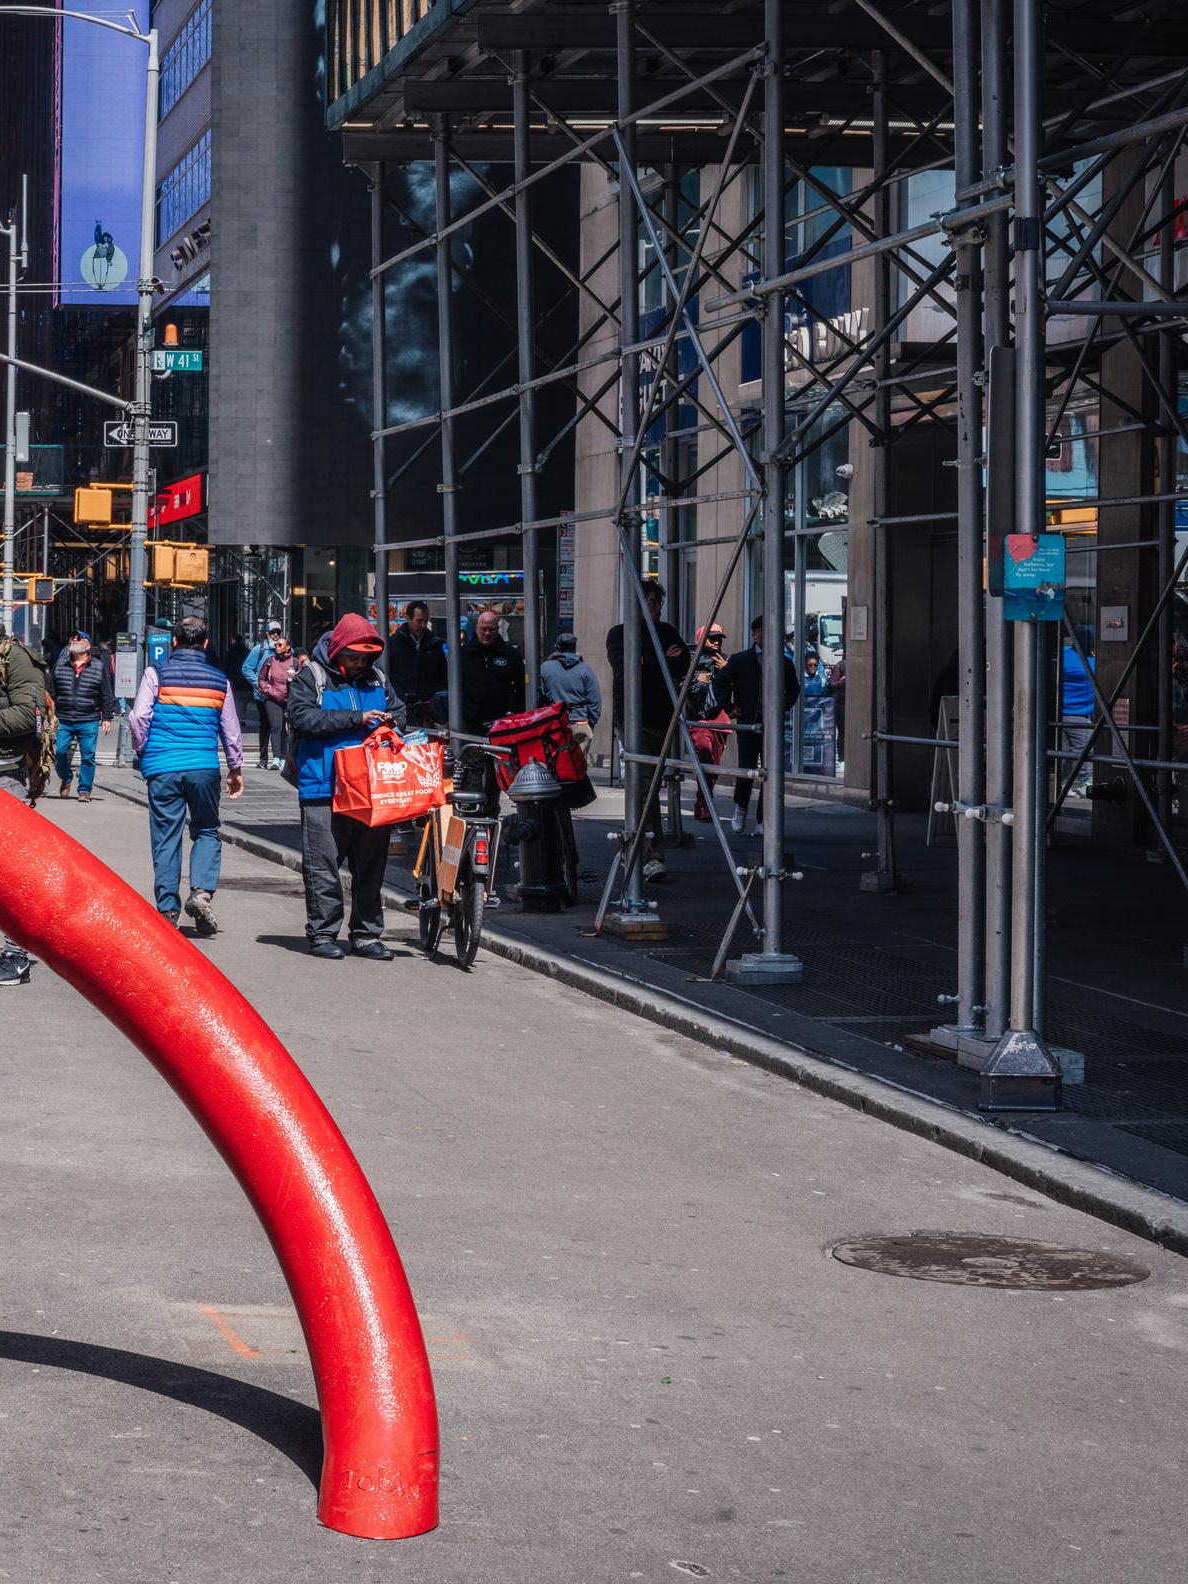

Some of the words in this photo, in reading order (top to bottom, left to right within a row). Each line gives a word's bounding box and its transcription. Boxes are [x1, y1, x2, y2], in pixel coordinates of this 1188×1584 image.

[166, 354, 174, 367] W
[178, 354, 189, 367] 41
[148, 429, 169, 439] WAY
[155, 647, 164, 660] P
